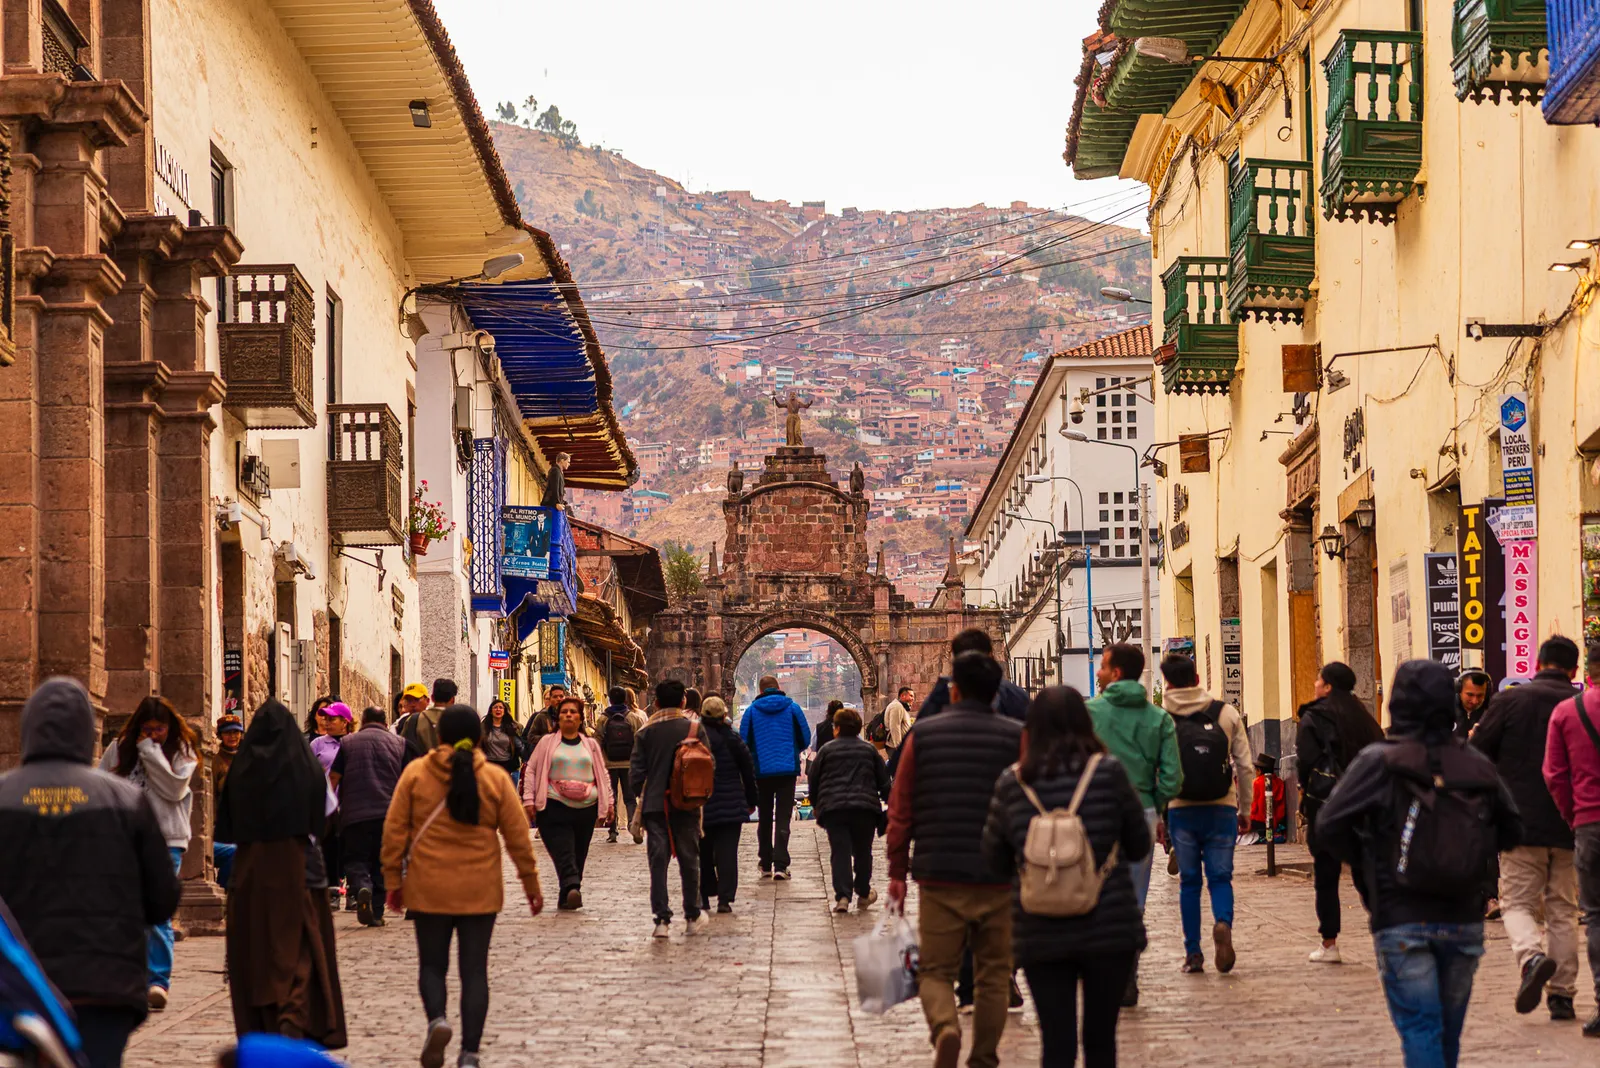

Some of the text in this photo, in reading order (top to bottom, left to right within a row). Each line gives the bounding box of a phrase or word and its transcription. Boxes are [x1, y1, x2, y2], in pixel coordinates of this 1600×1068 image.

[154, 137, 192, 209] NACIONAL
[1504, 434, 1526, 445] LOCAL
[1502, 444, 1530, 456] TREKKERS
[1513, 521, 1533, 529] SEPTEMBER
[1463, 507, 1484, 644] TATTOO
[1433, 601, 1459, 613] PUM
[1512, 546, 1530, 674] MASSAGES
